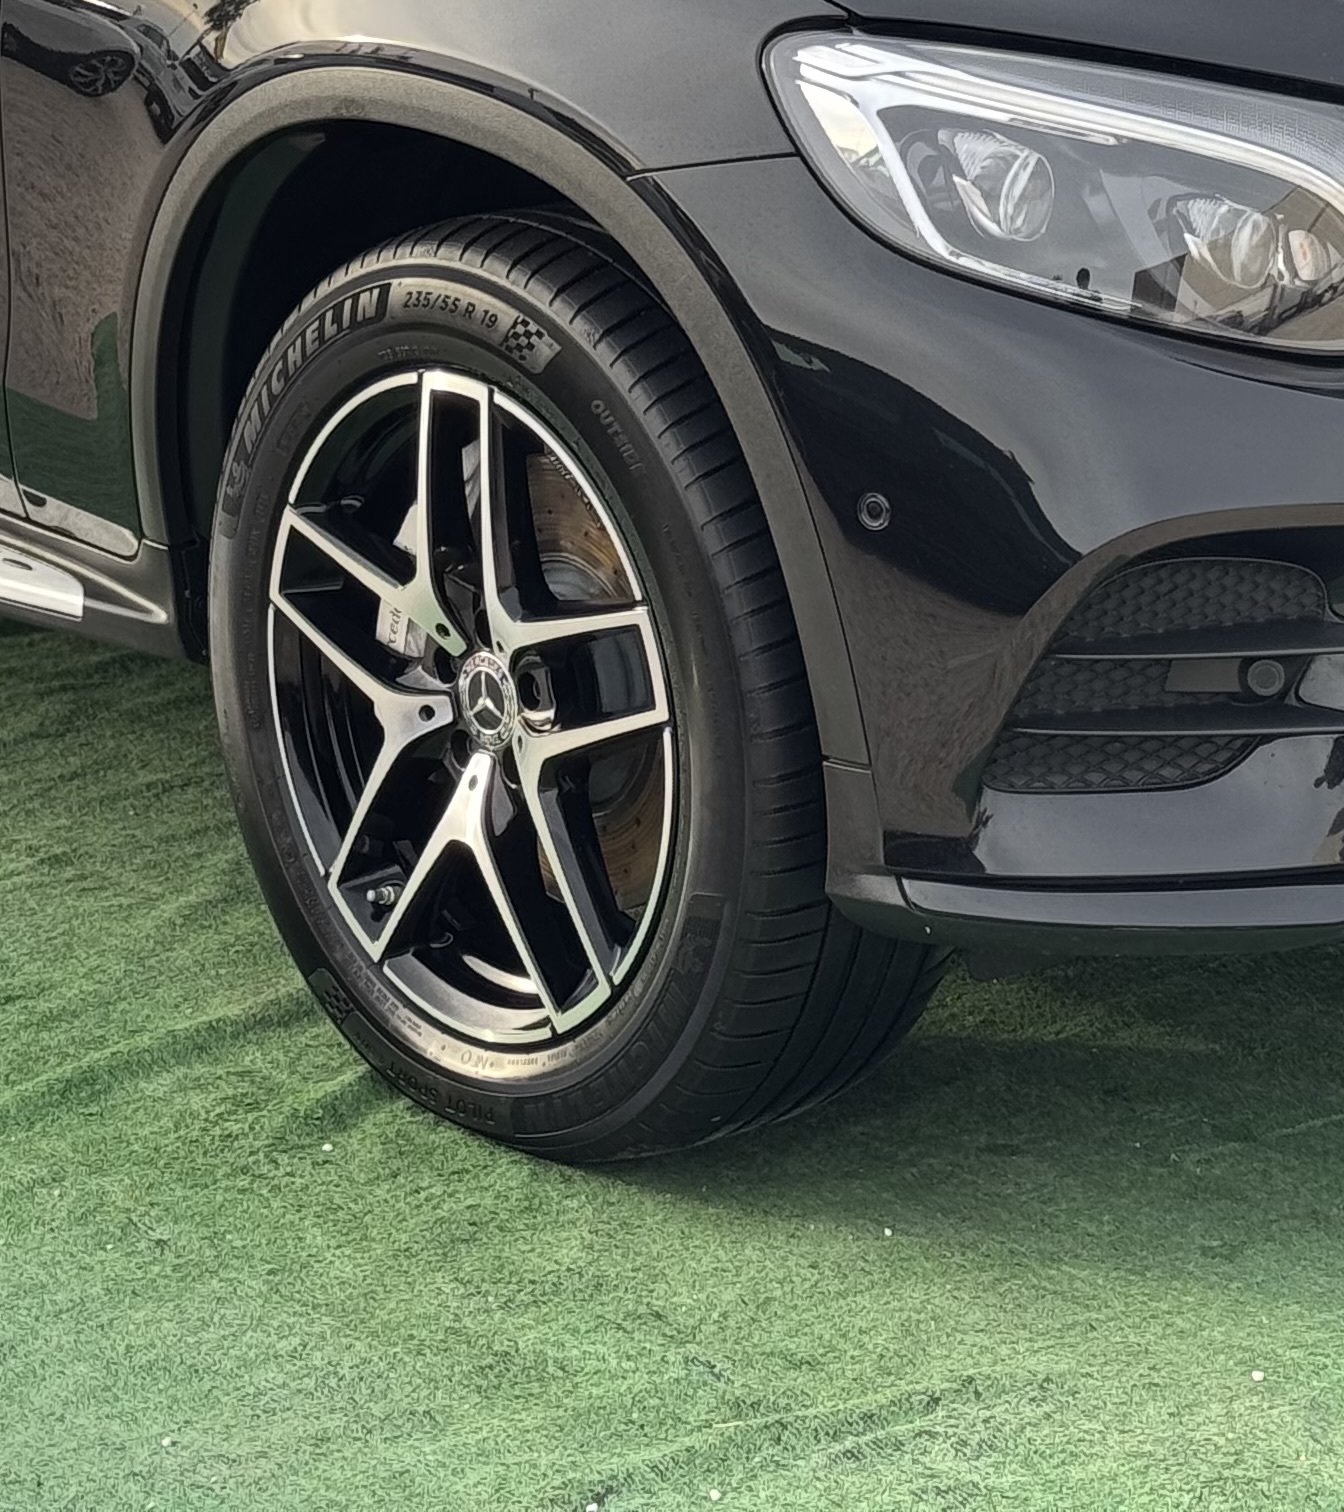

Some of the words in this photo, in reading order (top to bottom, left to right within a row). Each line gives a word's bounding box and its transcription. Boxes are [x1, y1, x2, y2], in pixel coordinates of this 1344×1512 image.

[402, 290, 460, 315] 235/55
[463, 301, 478, 320] R
[479, 307, 500, 330] 19
[243, 285, 383, 454] MICHELIN
